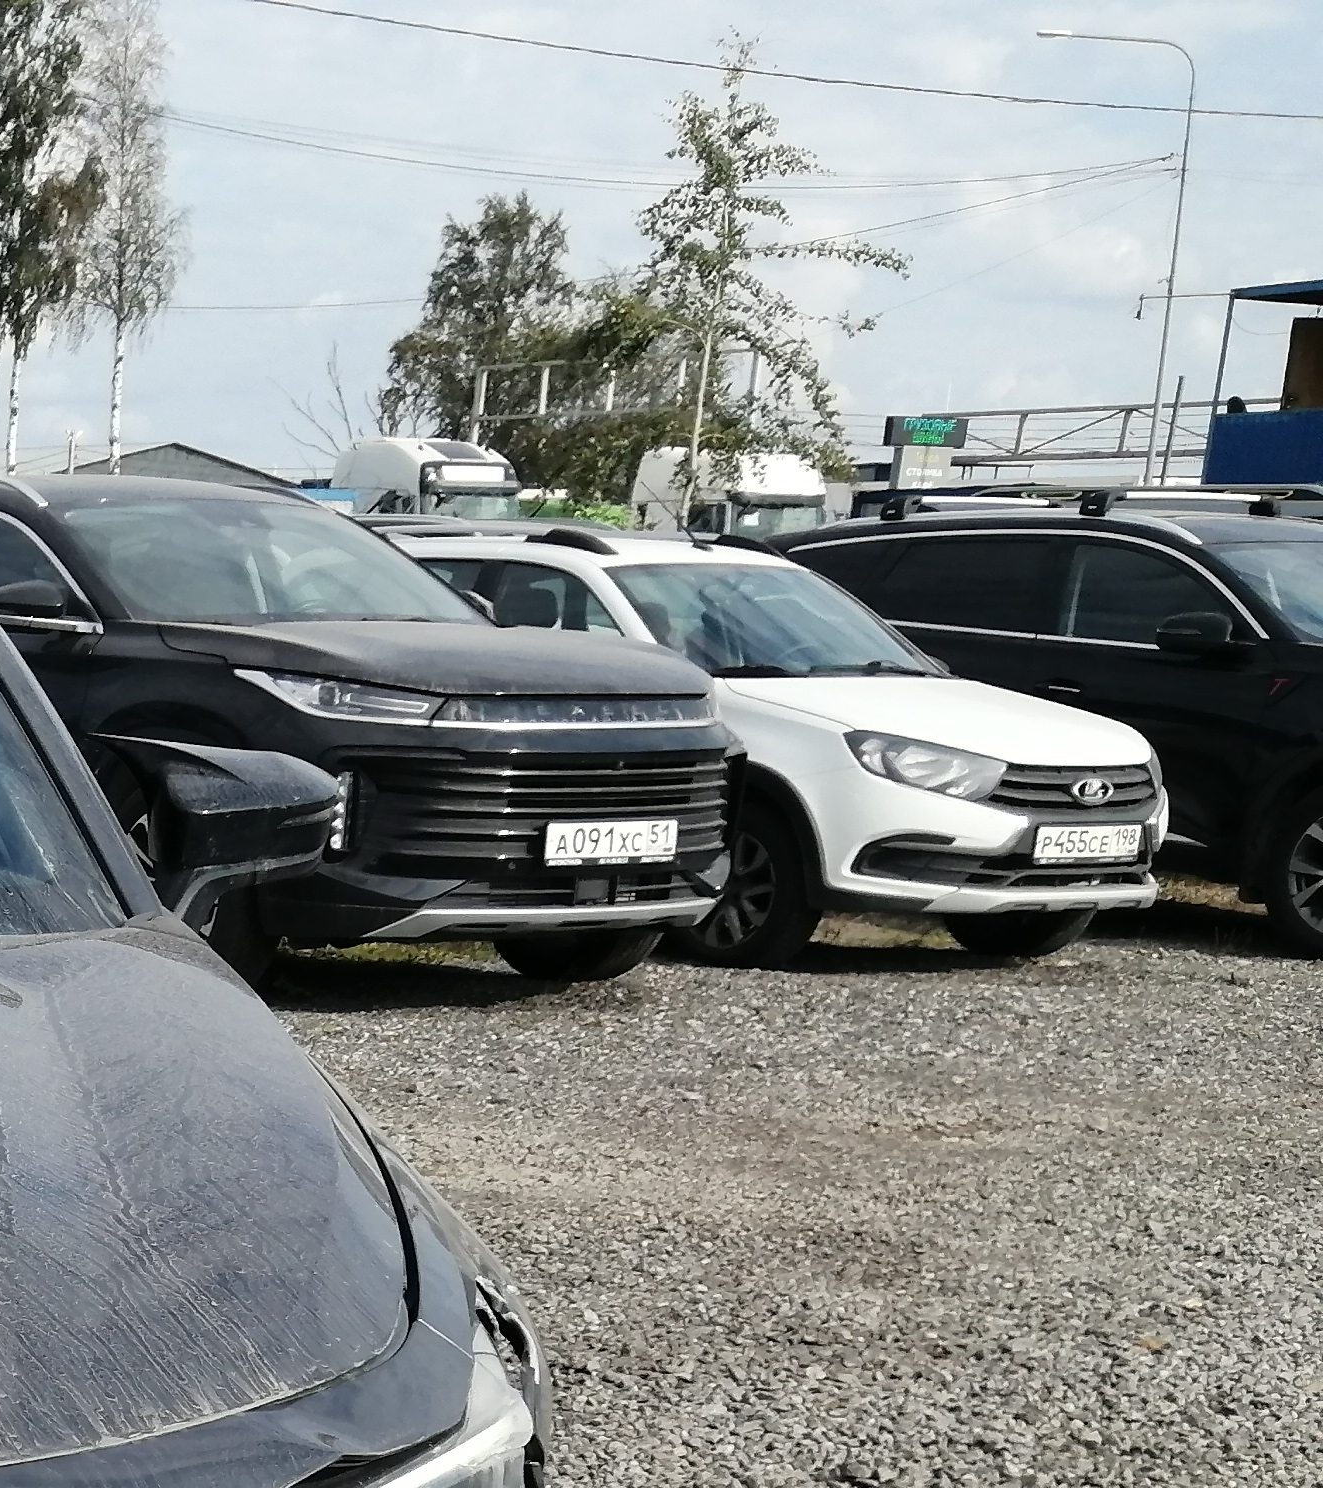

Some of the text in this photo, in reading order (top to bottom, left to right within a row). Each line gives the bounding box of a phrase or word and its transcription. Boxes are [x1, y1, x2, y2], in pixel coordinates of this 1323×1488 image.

[555, 824, 670, 855] А091ХС 51
[1041, 830, 1109, 854] Р455СЕ
